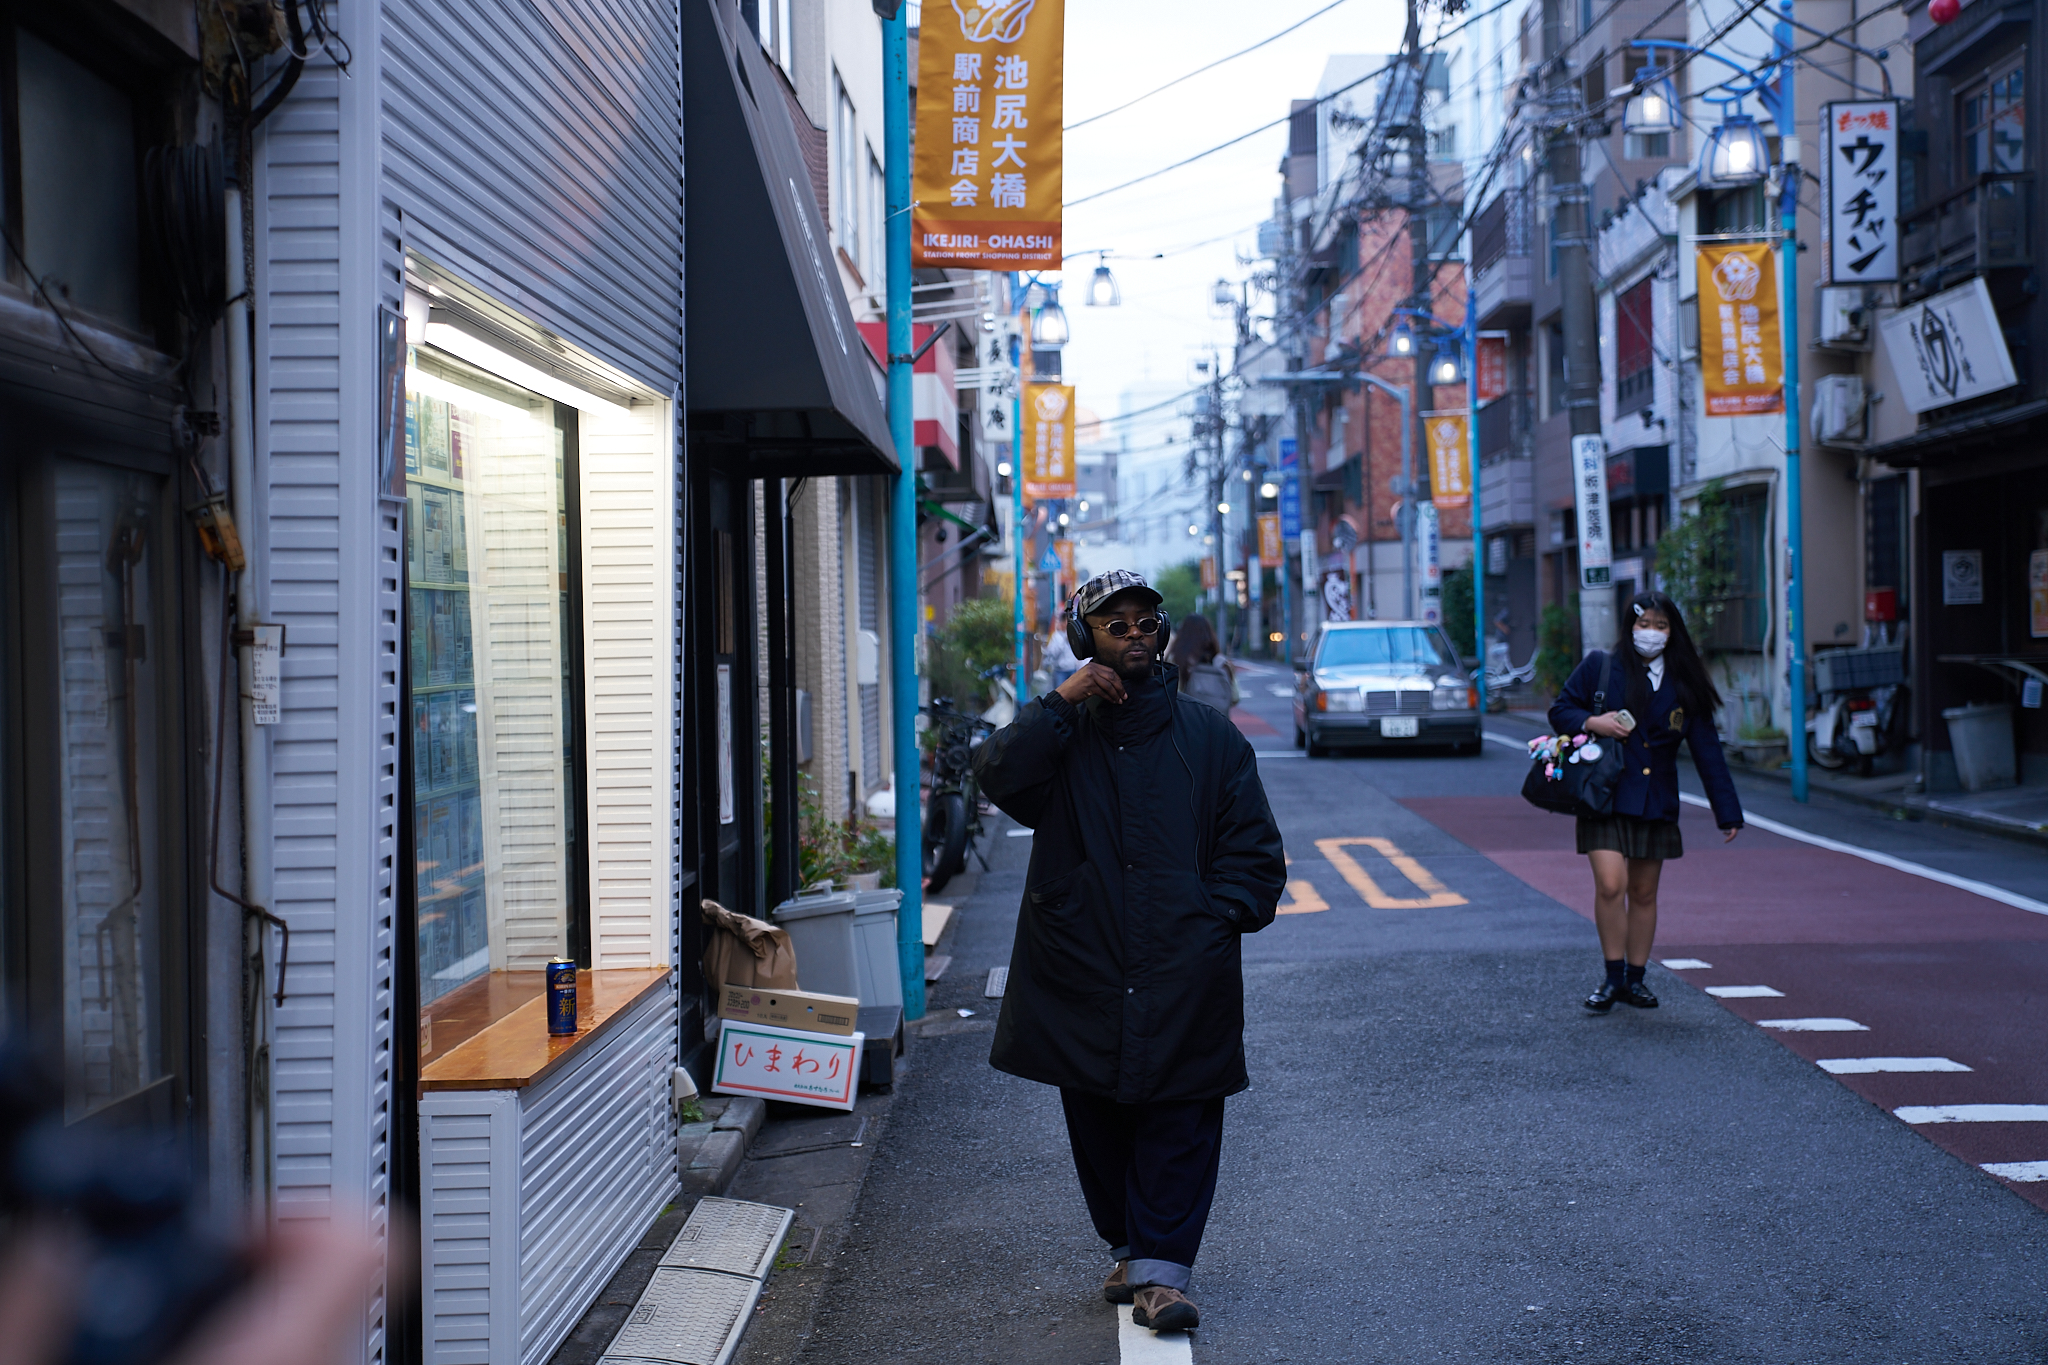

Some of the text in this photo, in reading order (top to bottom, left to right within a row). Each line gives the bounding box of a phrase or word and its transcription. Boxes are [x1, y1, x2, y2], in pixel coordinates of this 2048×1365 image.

[949, 53, 982, 207] 駅前商店会
[990, 55, 1029, 208] 池尻大橋
[1839, 136, 1887, 275] ウッチャン
[923, 251, 954, 259] STATION
[559, 997, 575, 1017] 新
[733, 1042, 841, 1080] ひまわり
